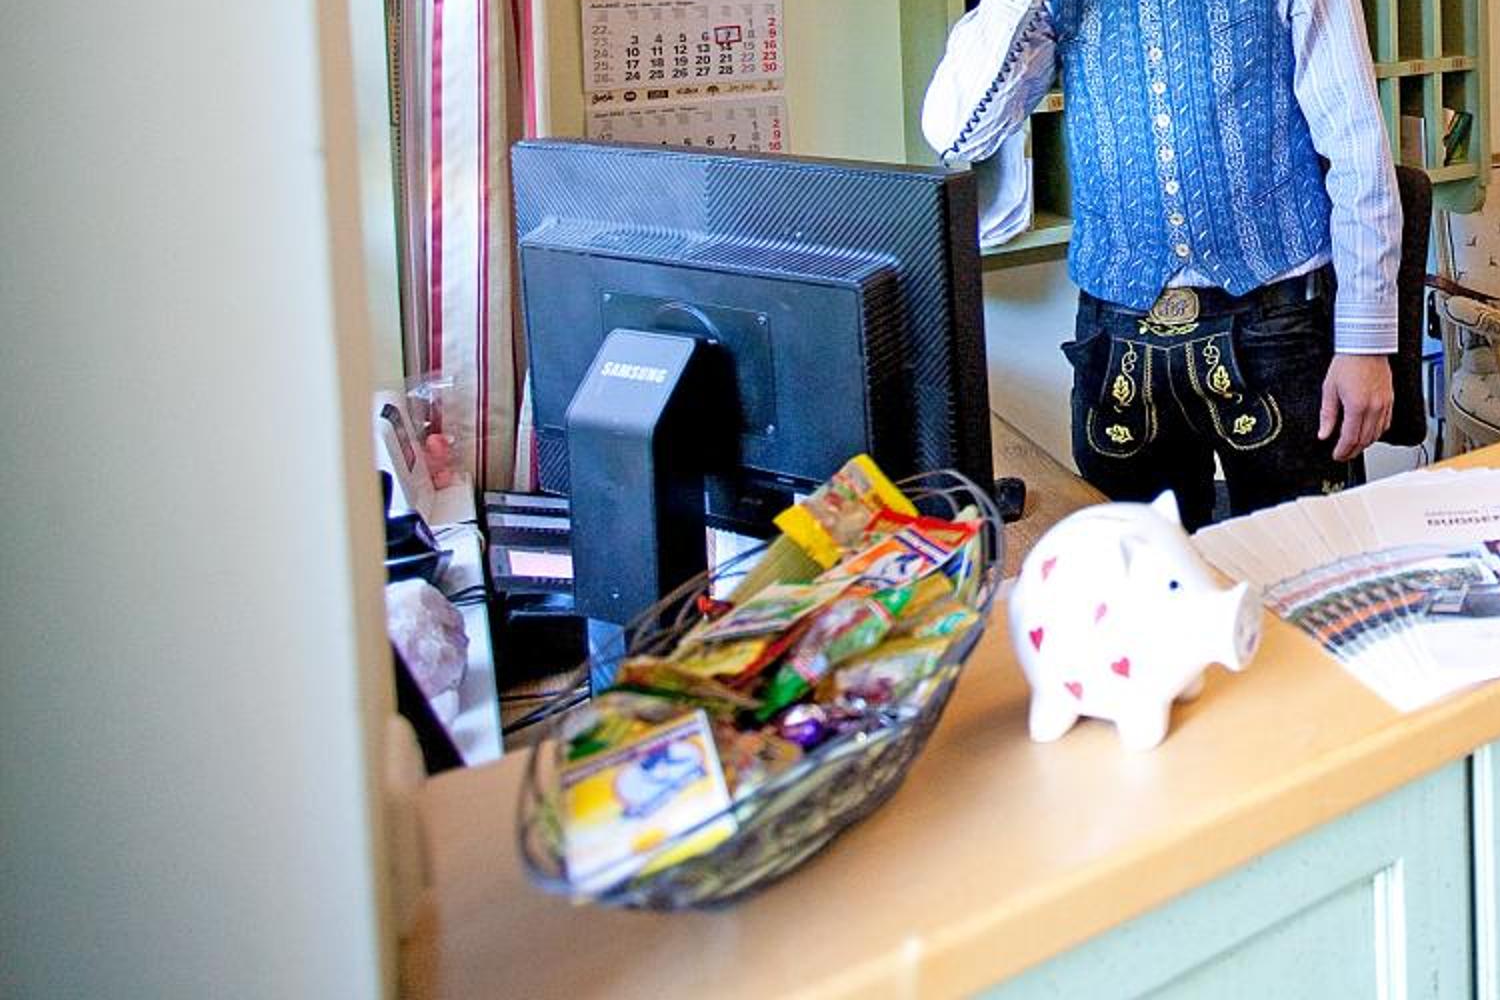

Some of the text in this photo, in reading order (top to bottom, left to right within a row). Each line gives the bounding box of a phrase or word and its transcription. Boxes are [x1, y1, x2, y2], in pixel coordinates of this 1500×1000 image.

[768, 17, 777, 27] 2
[630, 35, 639, 44] 3
[655, 33, 663, 43] 4
[679, 33, 687, 42] 5
[702, 31, 709, 41] 6
[768, 28, 776, 38] 9
[626, 47, 640, 57] 10
[651, 46, 663, 56] 11
[673, 44, 687, 54] 12
[697, 44, 710, 53] 13
[763, 40, 777, 49] 16
[626, 60, 640, 69] 17
[650, 58, 664, 67] 18
[674, 56, 688, 66] 19
[696, 56, 710, 65] 20
[720, 54, 732, 63] 21
[763, 52, 777, 61] 23
[625, 71, 640, 80] 24
[649, 70, 664, 79] 25
[672, 68, 688, 78] 26
[696, 66, 710, 77] 27
[719, 65, 733, 75] 28
[762, 62, 777, 72] 30
[773, 119, 780, 128] 2
[706, 136, 715, 146] 6
[728, 133, 737, 144] 7
[774, 129, 781, 139] 9
[601, 360, 669, 384] SAMSUNG
